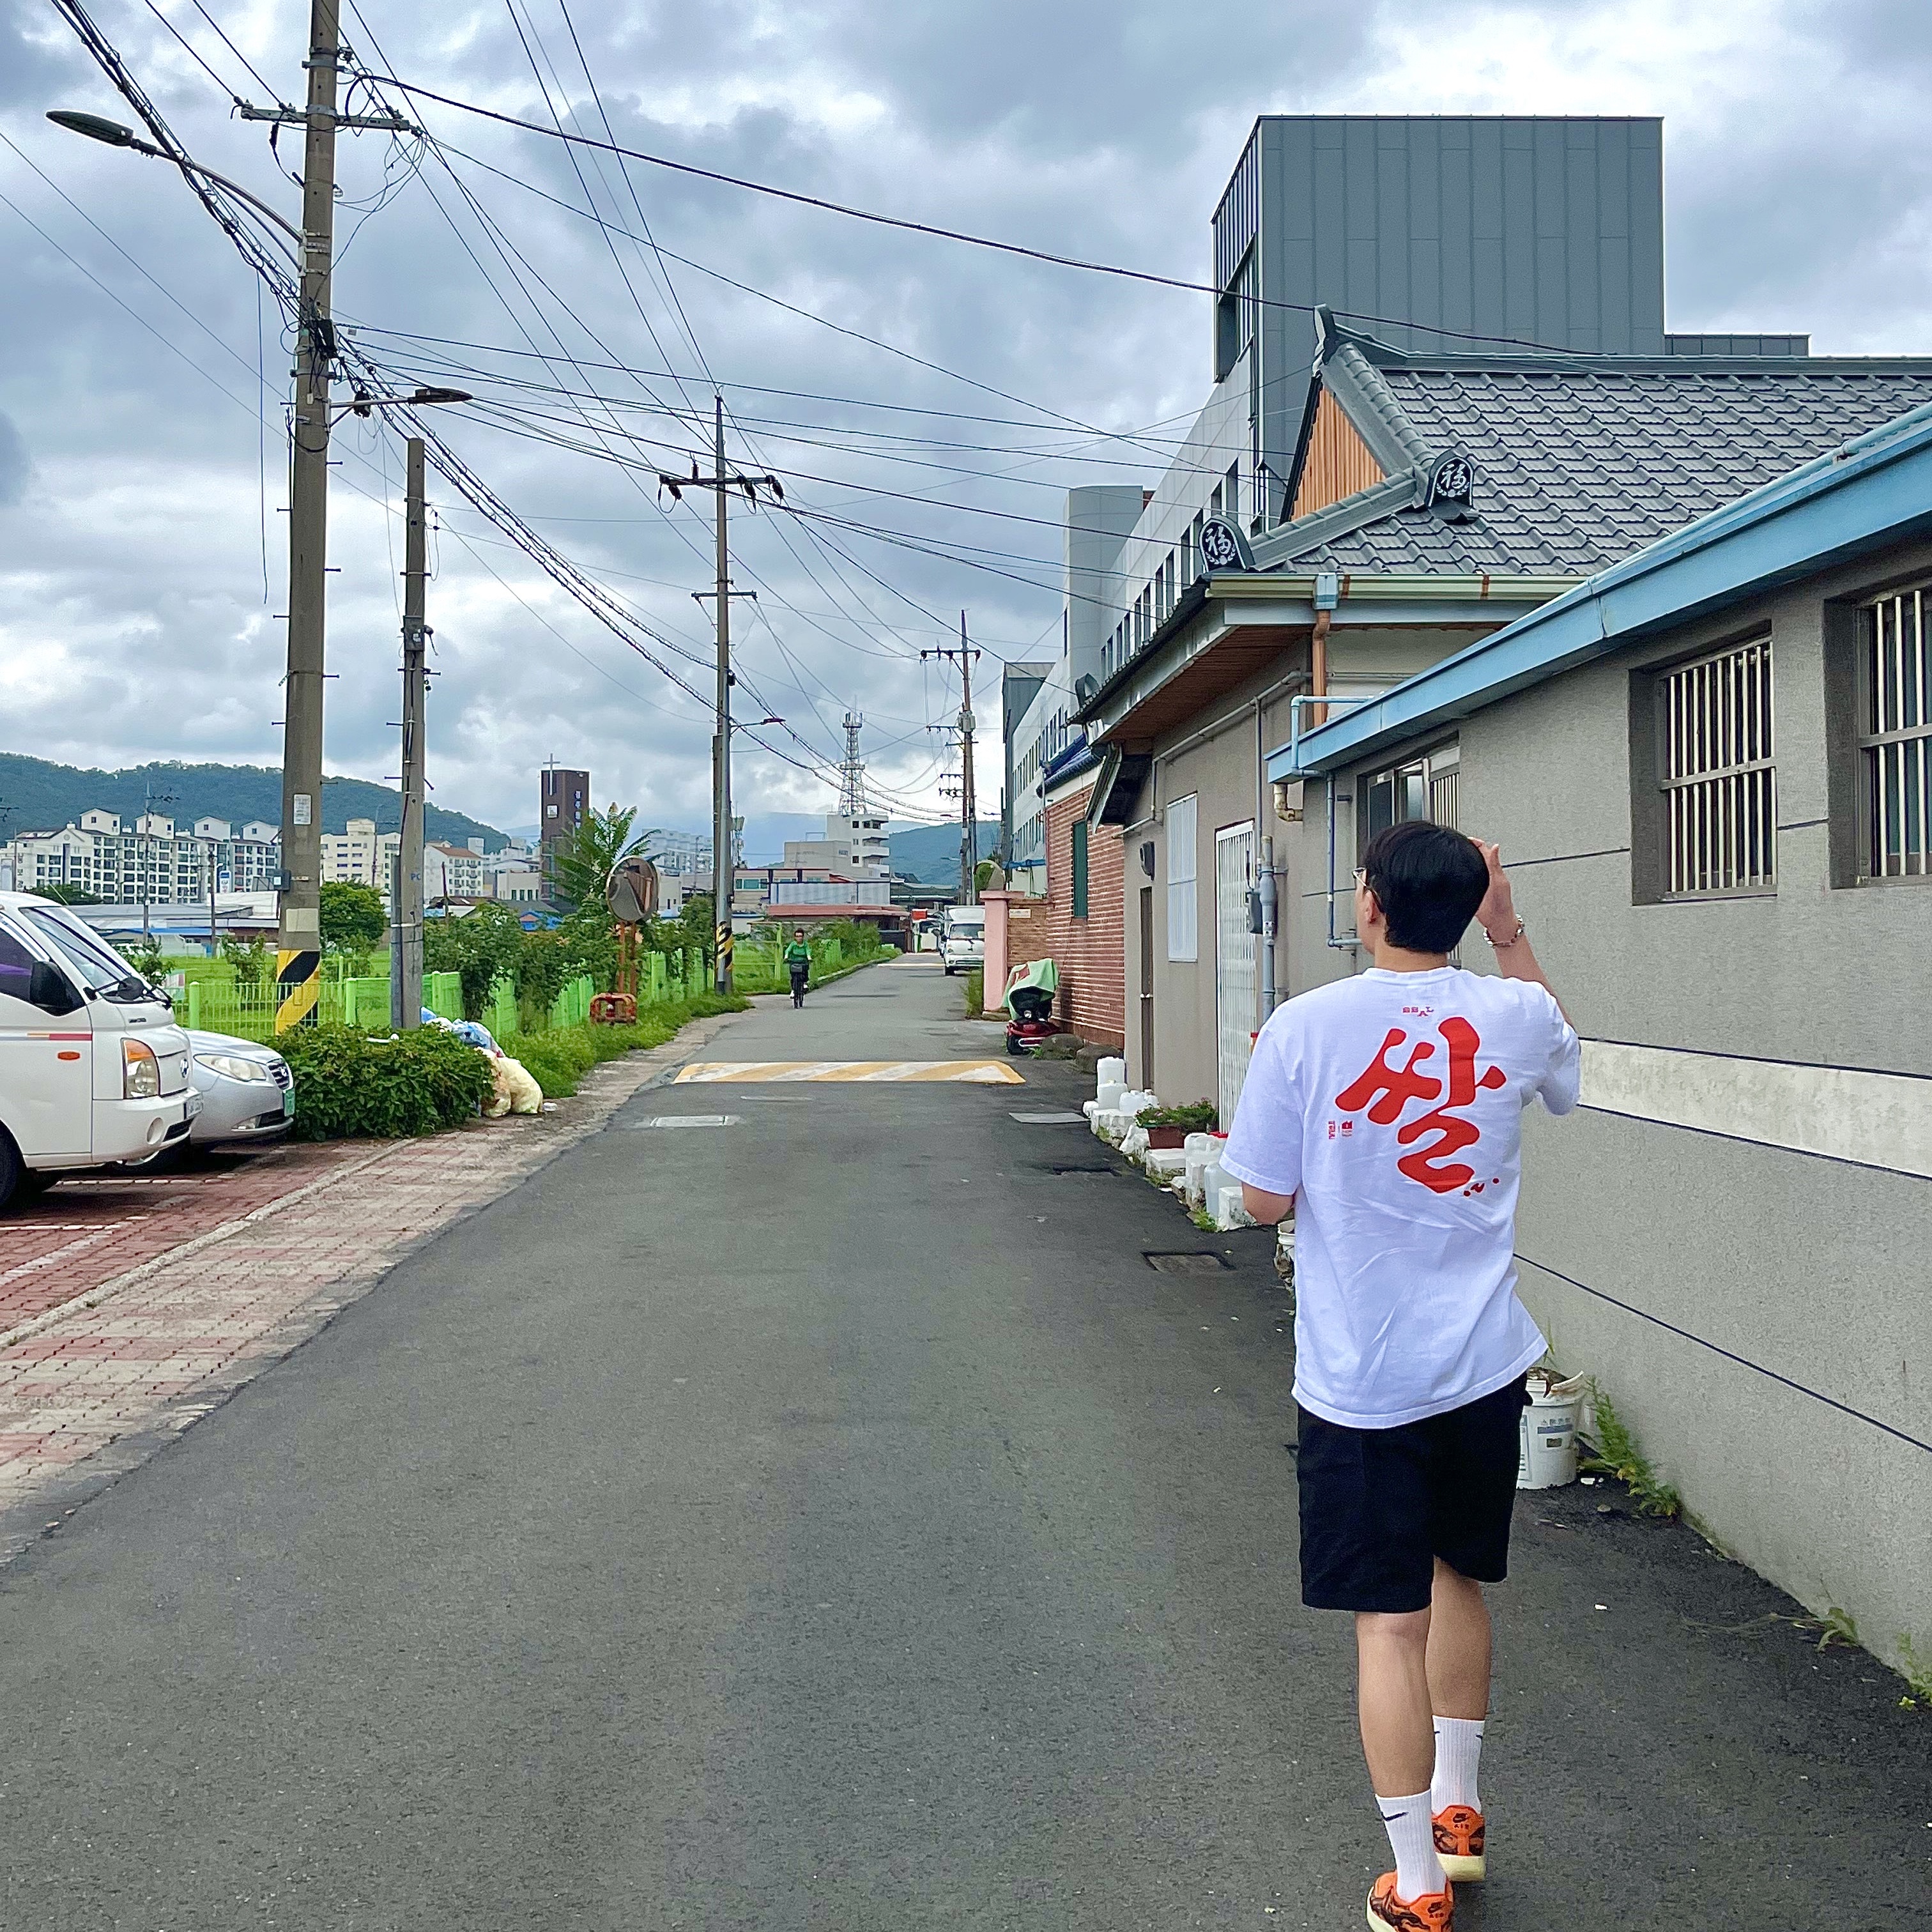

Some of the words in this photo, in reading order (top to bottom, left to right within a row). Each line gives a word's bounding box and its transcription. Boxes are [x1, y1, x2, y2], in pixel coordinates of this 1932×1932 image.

[1441, 463, 1466, 489] 福
[1205, 526, 1232, 556] 福
[1335, 1016, 1506, 1193] 쌀
